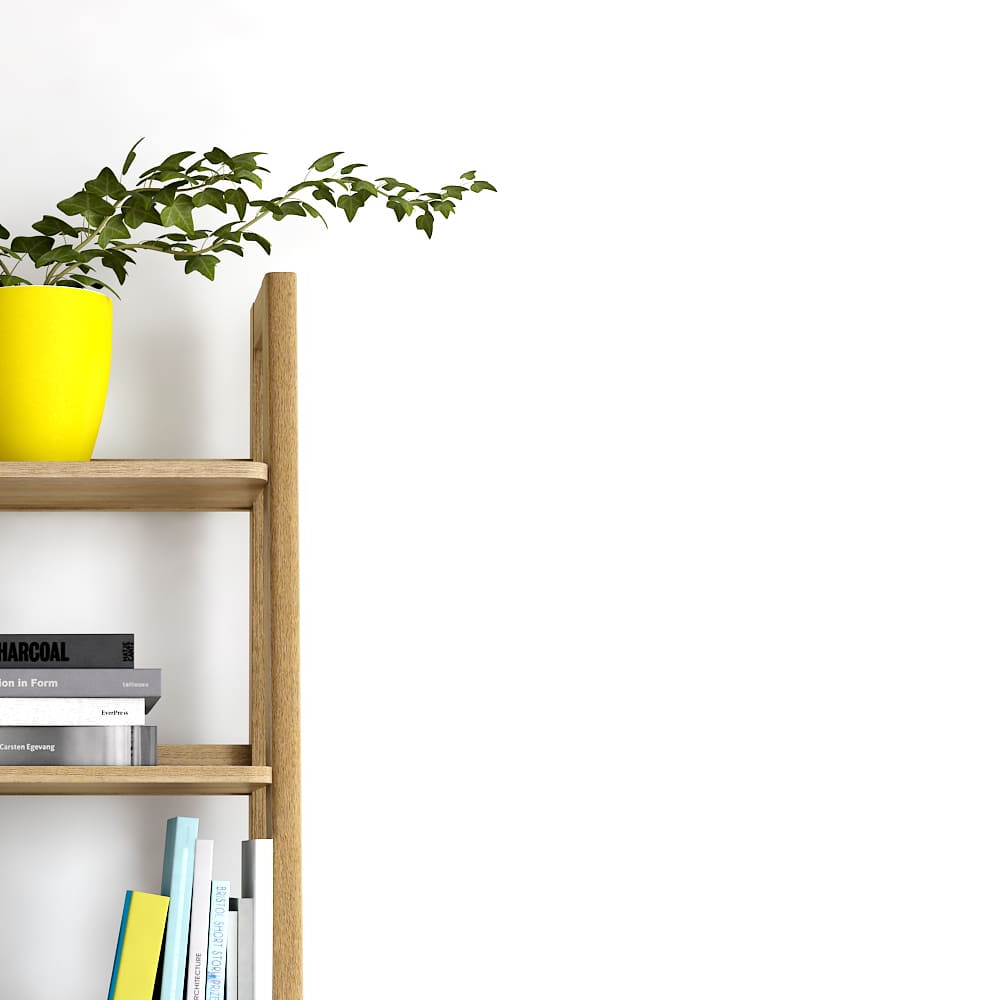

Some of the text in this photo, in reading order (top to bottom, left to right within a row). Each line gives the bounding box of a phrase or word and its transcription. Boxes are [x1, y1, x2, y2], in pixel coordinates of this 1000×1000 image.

[17, 678, 28, 688] in
[30, 678, 58, 688] Form
[0, 743, 55, 752] Carsten Egevang
[215, 886, 227, 918] BRISTOL
[213, 921, 225, 947] SHORT
